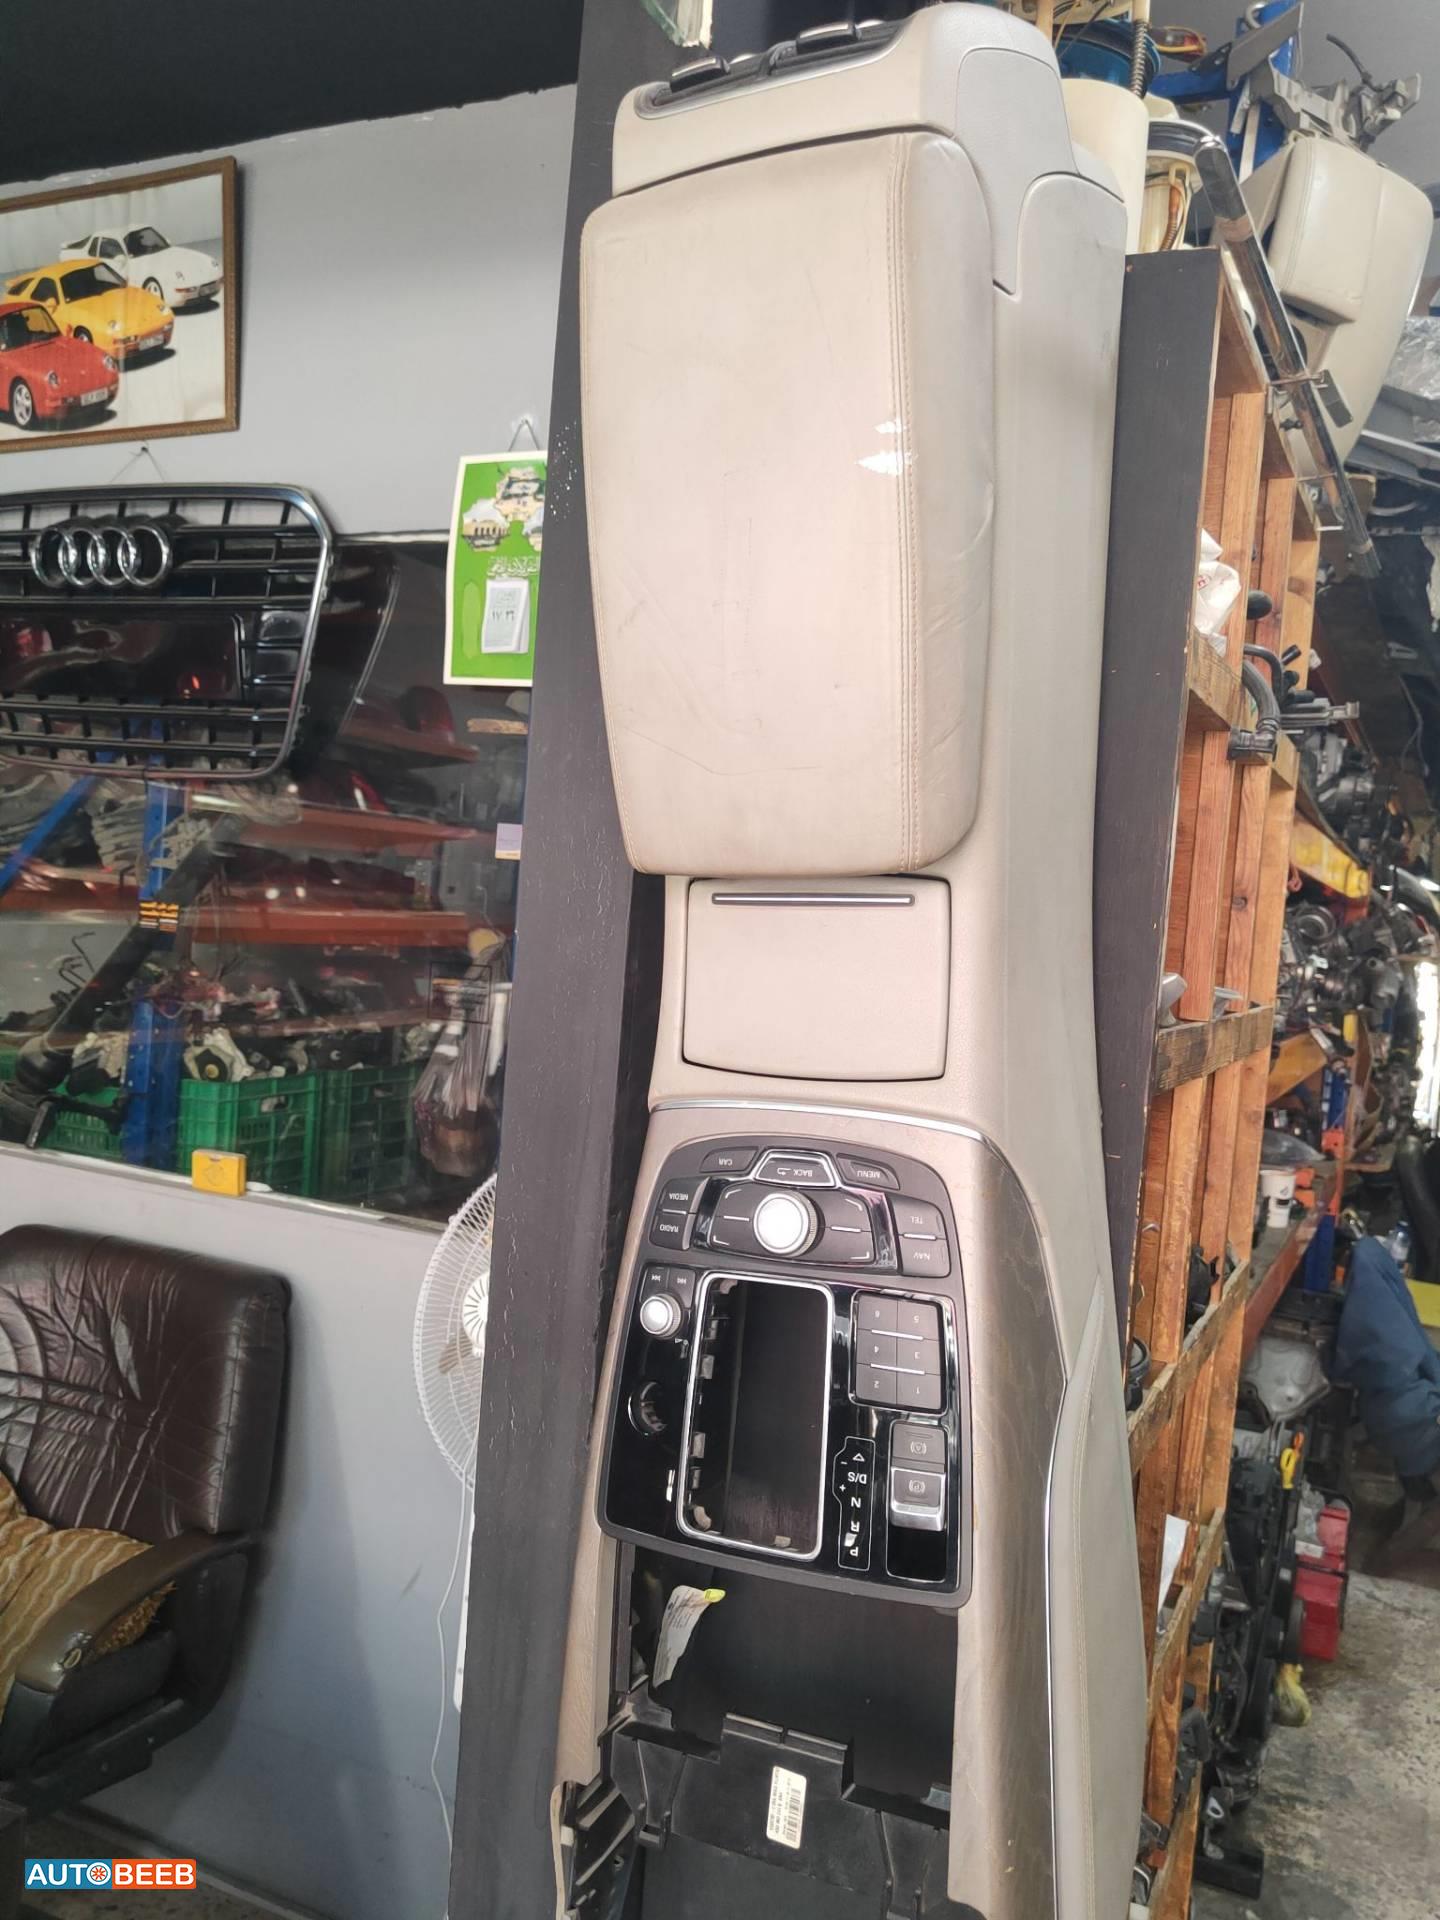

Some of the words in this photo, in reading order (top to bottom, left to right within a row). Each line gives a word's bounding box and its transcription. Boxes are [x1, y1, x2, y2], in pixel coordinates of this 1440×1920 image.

[718, 1158, 733, 1167] CAR
[793, 1168, 813, 1178] BACK
[856, 1170, 880, 1179] MENU
[668, 1192, 689, 1201] MEDIA
[910, 1215, 923, 1225] TEL
[659, 1223, 679, 1233] RADIO
[913, 1251, 931, 1261] NAV
[847, 1471, 868, 1485] D/S
[850, 1496, 862, 1509] N
[850, 1520, 860, 1533] R
[849, 1546, 859, 1558] P
